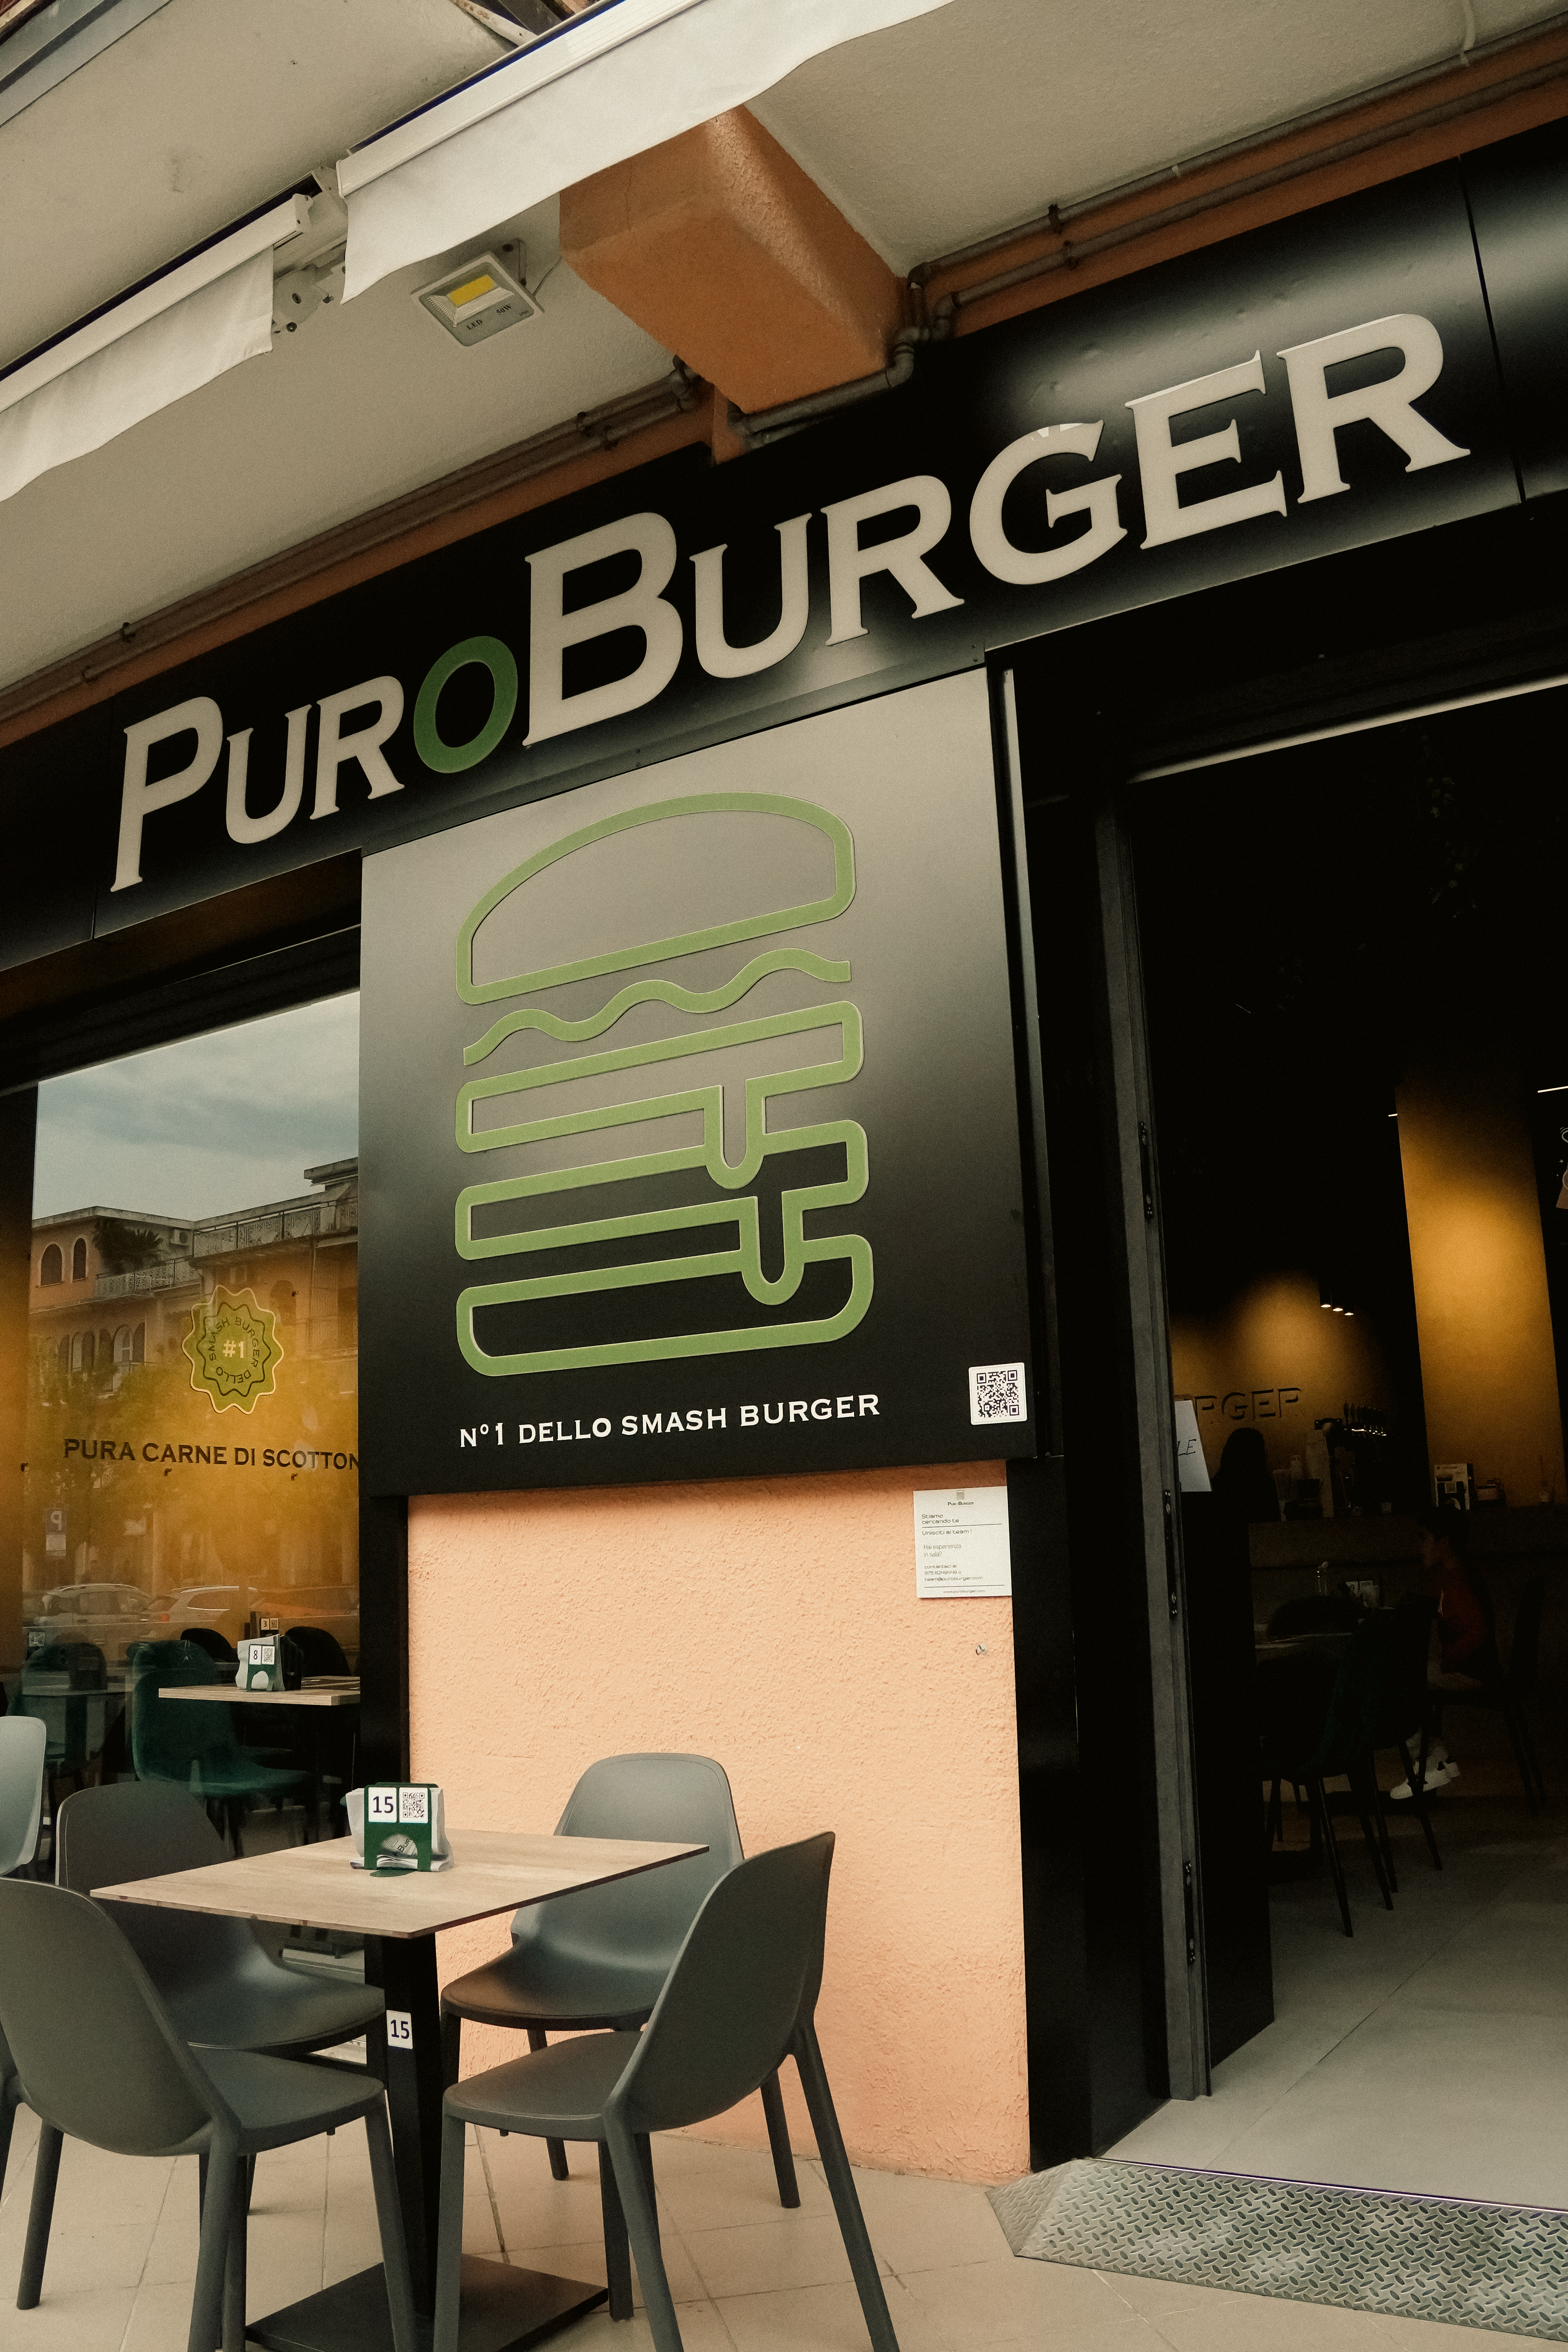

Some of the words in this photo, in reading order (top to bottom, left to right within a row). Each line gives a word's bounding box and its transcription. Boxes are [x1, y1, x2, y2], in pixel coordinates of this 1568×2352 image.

[466, 319, 483, 330] LED
[496, 304, 512, 316] 50W
[208, 1317, 230, 1362] SMASH
[235, 1317, 260, 1367] BURGER
[223, 1339, 245, 1358] #1
[216, 1367, 252, 1384] DELLO
[519, 1417, 612, 1444] DELLO
[622, 1407, 726, 1436] SMASH
[740, 1394, 880, 1426] BURGER
[63, 1438, 136, 1461] PURA
[142, 1443, 227, 1465] CARNE
[234, 1447, 255, 1466] DI
[253, 1650, 258, 1660] 8
[373, 1796, 394, 1814] 15
[397, 1838, 412, 1853] BUR
[390, 2019, 410, 2039] 15
